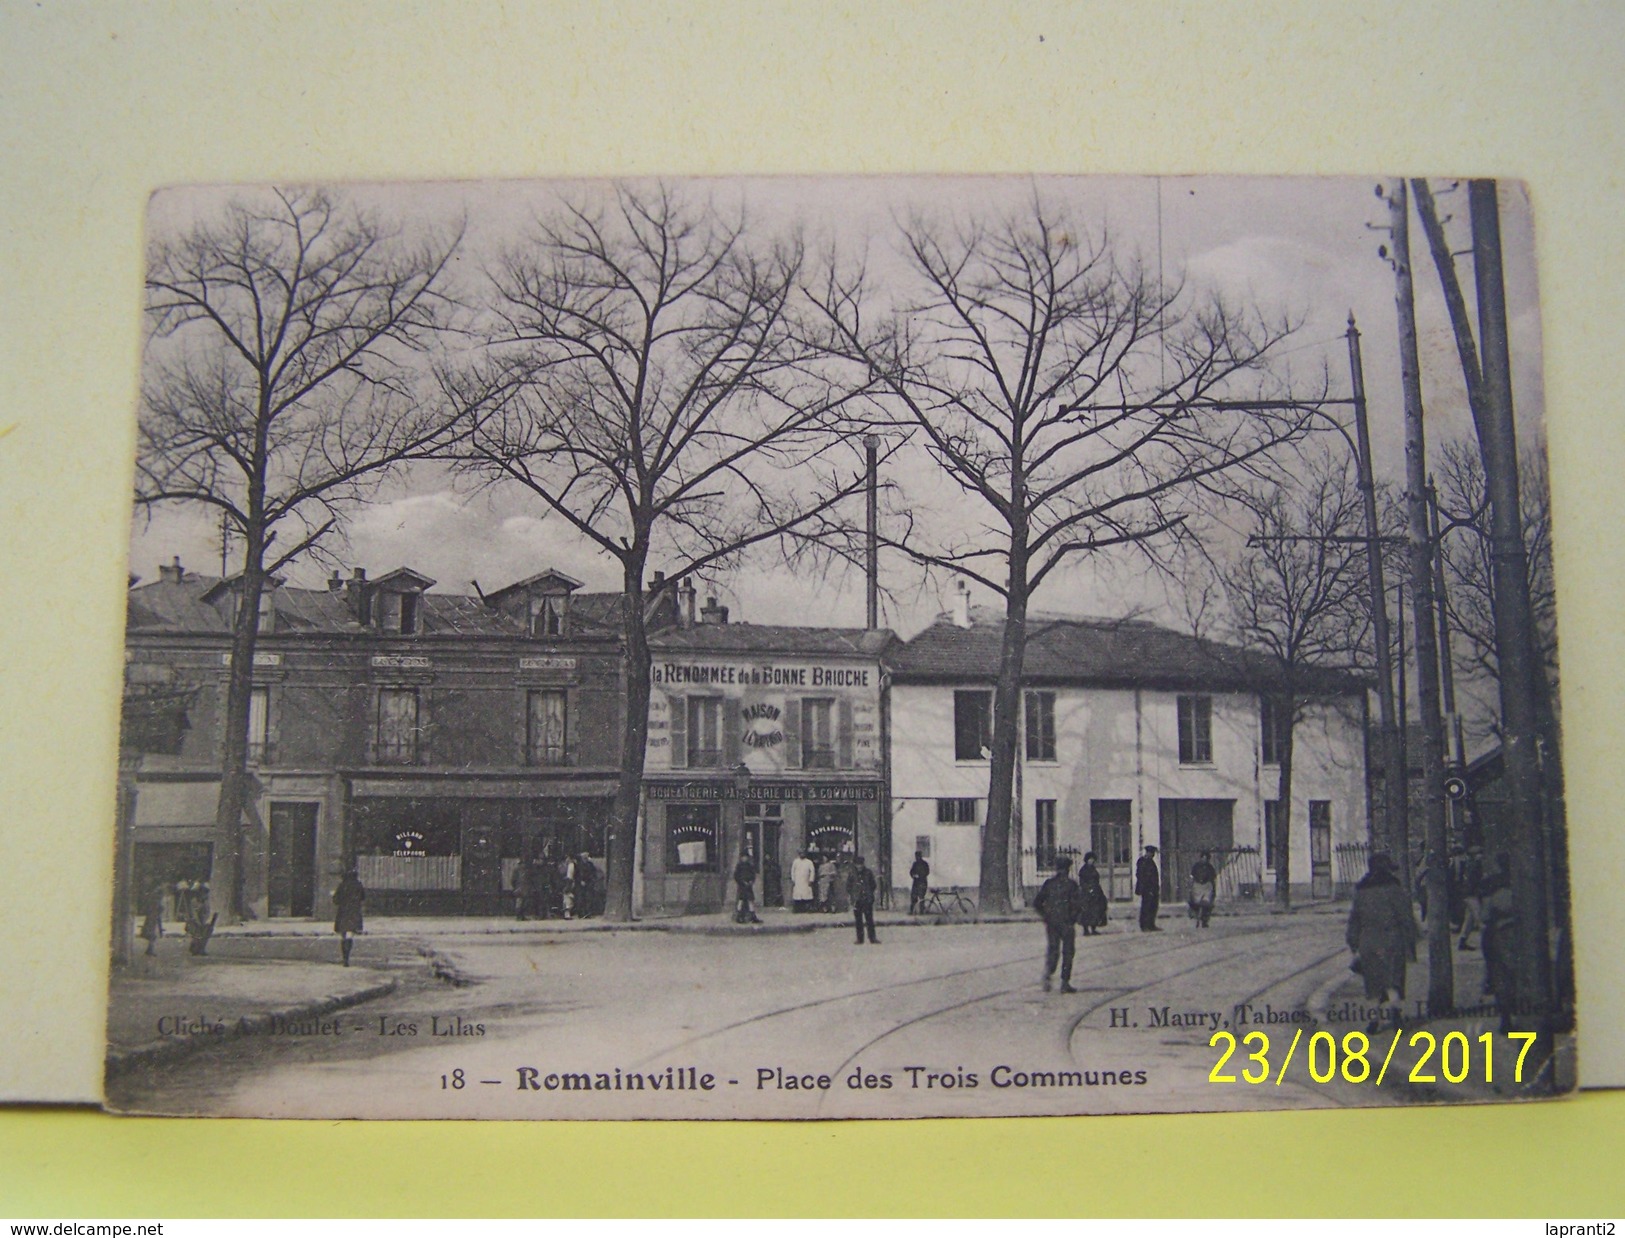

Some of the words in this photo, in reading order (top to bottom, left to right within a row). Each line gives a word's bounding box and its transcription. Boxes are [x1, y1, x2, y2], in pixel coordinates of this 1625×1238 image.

[652, 665, 662, 683] la
[738, 668, 750, 684] de
[751, 667, 761, 685] la
[763, 665, 806, 686] BONNE
[812, 666, 869, 687] BRIOCHE
[741, 703, 781, 722] MAISON
[650, 785, 719, 799] BOULANGERIE
[820, 786, 875, 800] COMMUNES
[395, 831, 424, 840] BILLARD
[157, 1015, 225, 1037] Cliché
[270, 1015, 342, 1037] Boulet
[378, 1015, 418, 1037] Les
[431, 1014, 486, 1037] Lilas
[1109, 1007, 1138, 1029] H.
[1147, 1006, 1230, 1031] Maury,
[1235, 1004, 1319, 1027] Tabacs,
[441, 1067, 466, 1090] 18
[516, 1065, 716, 1091] Romainville
[756, 1067, 832, 1091] Place
[846, 1066, 893, 1089] des
[904, 1066, 979, 1089] Trois
[990, 1065, 1148, 1088] Communes
